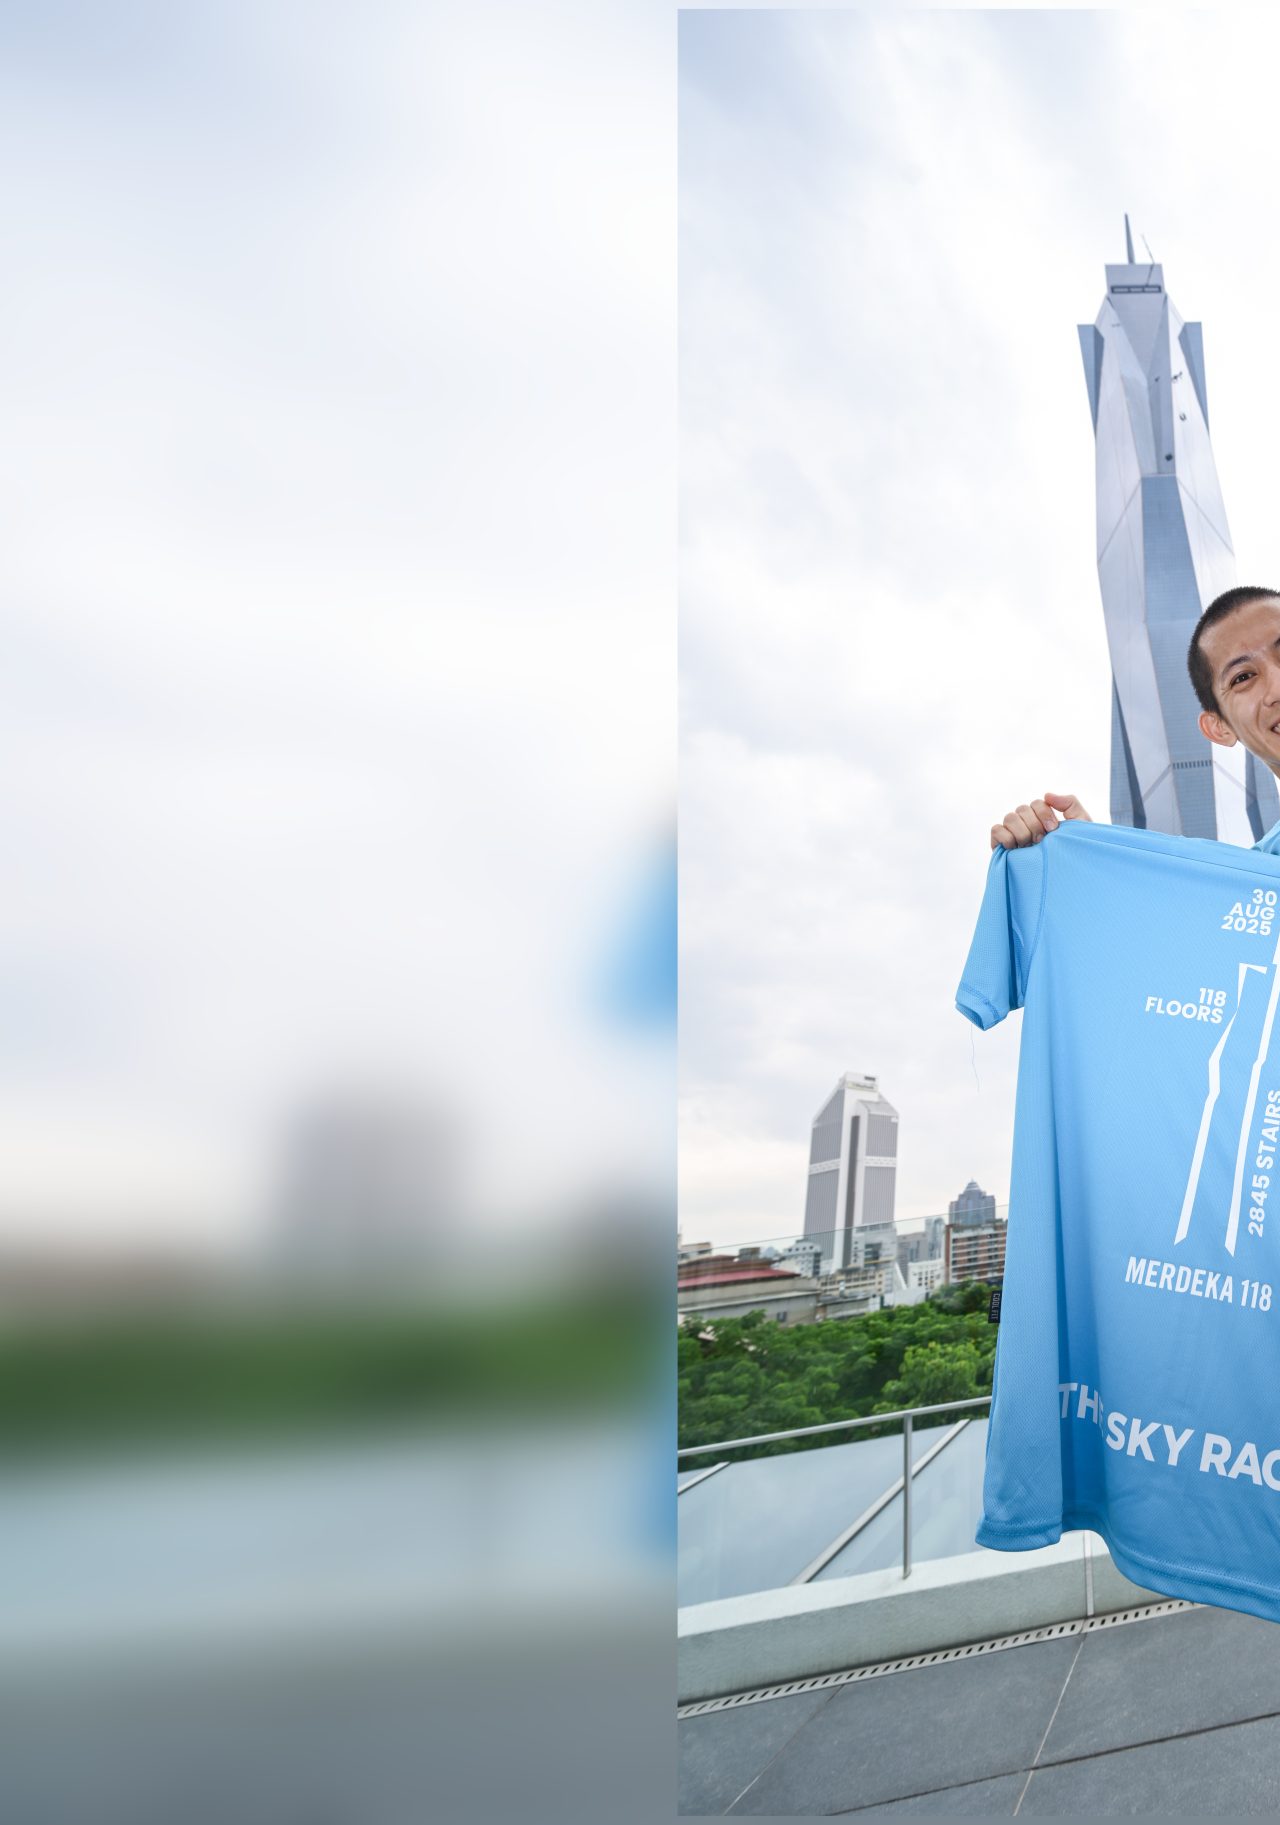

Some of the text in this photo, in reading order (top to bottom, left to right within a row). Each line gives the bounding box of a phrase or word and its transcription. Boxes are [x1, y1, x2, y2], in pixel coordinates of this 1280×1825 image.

[1252, 889, 1277, 906] 30
[1229, 902, 1275, 920] AUG
[1221, 916, 1271, 936] 2025
[1199, 988, 1226, 1006] 118
[1145, 996, 1223, 1024] FLOORS
[1248, 1175, 1270, 1237] 2845
[1124, 1256, 1272, 1312] MERDEKA 118
[1058, 1383, 1103, 1430] TH
[1105, 1412, 1195, 1467] SKY
